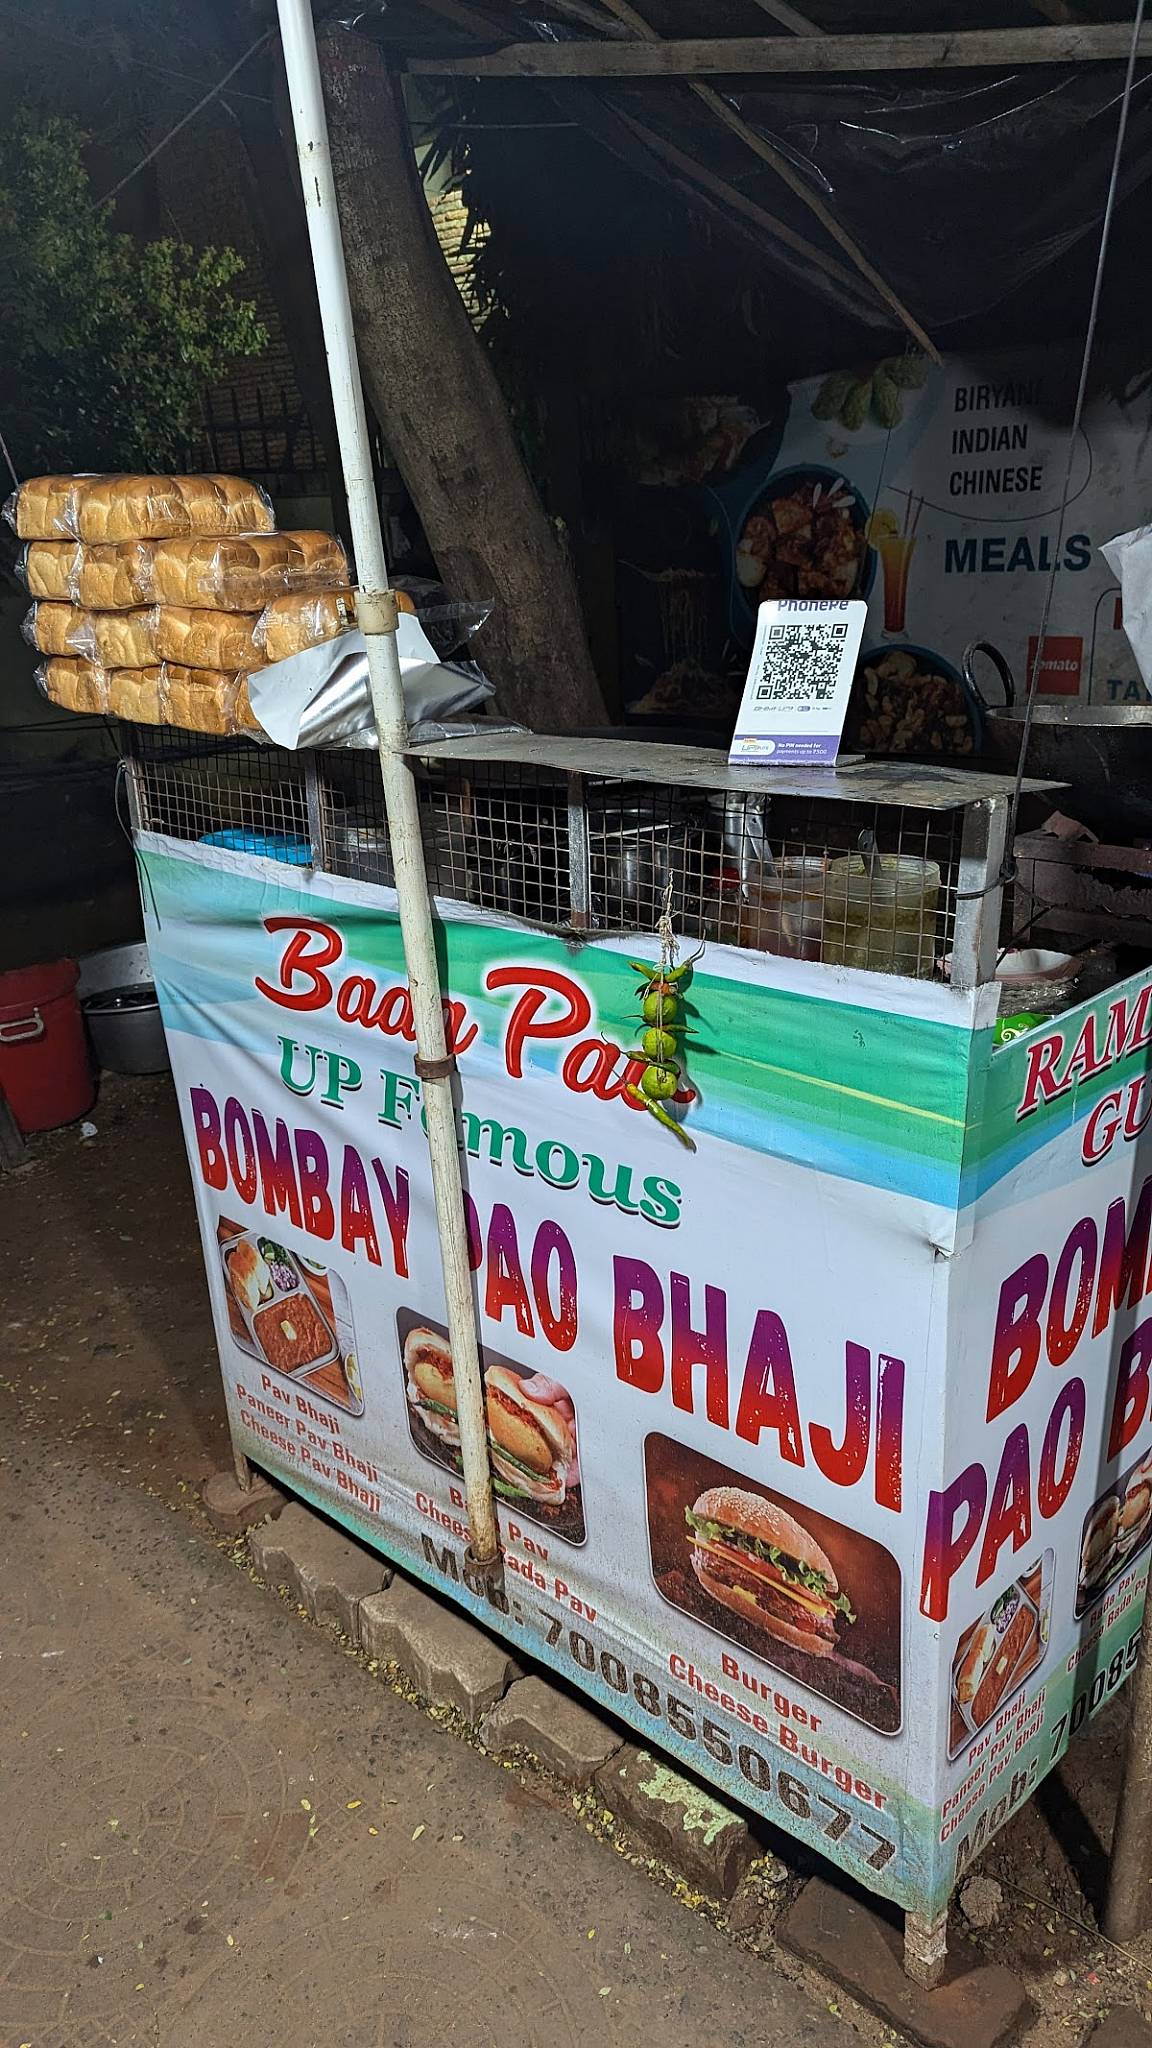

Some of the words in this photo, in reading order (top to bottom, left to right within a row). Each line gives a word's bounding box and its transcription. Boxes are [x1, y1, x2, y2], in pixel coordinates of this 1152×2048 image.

[952, 424, 1028, 455] INDIAN
[950, 466, 1043, 496] CHINESE
[945, 534, 1092, 573] MEALS
[777, 600, 849, 612] PhonePe
[1106, 680, 1152, 702] TA
[277, 1035, 362, 1110] UP
[378, 1069, 683, 1229] Fmous
[188, 1087, 410, 1279] BOMBAY
[612, 1254, 906, 1514] BHAJI
[236, 1384, 290, 1430] Paneer
[297, 1420, 327, 1453] Pav
[333, 1441, 380, 1484] Bhaji
[261, 1374, 291, 1409] Pav
[297, 1395, 341, 1436] Bhaji
[240, 1410, 297, 1456] Cheese
[301, 1447, 331, 1480] Pav
[337, 1470, 381, 1514] Bhaji
[919, 1376, 1087, 1622] PAO
[415, 1491, 474, 1544] Chees
[554, 1575, 597, 1623] Pav
[508, 1520, 550, 1562] Pav
[1106, 1593, 1133, 1629] Bada
[1117, 1570, 1137, 1596] Pav
[669, 1653, 770, 1736] Cheese
[779, 1727, 888, 1812] Burger
[721, 1652, 823, 1734] Burger
[968, 1733, 992, 1767] Pav
[994, 1690, 1027, 1736] Bhaji
[538, 1610, 898, 1873] 7008550677
[939, 1782, 986, 1844] Cheese
[988, 1752, 1011, 1785] Pav
[1013, 1711, 1044, 1755] Bhaji
[941, 1758, 987, 1820] Paneer
[989, 1728, 1013, 1763] Pav
[1015, 1688, 1047, 1733] Bhaji
